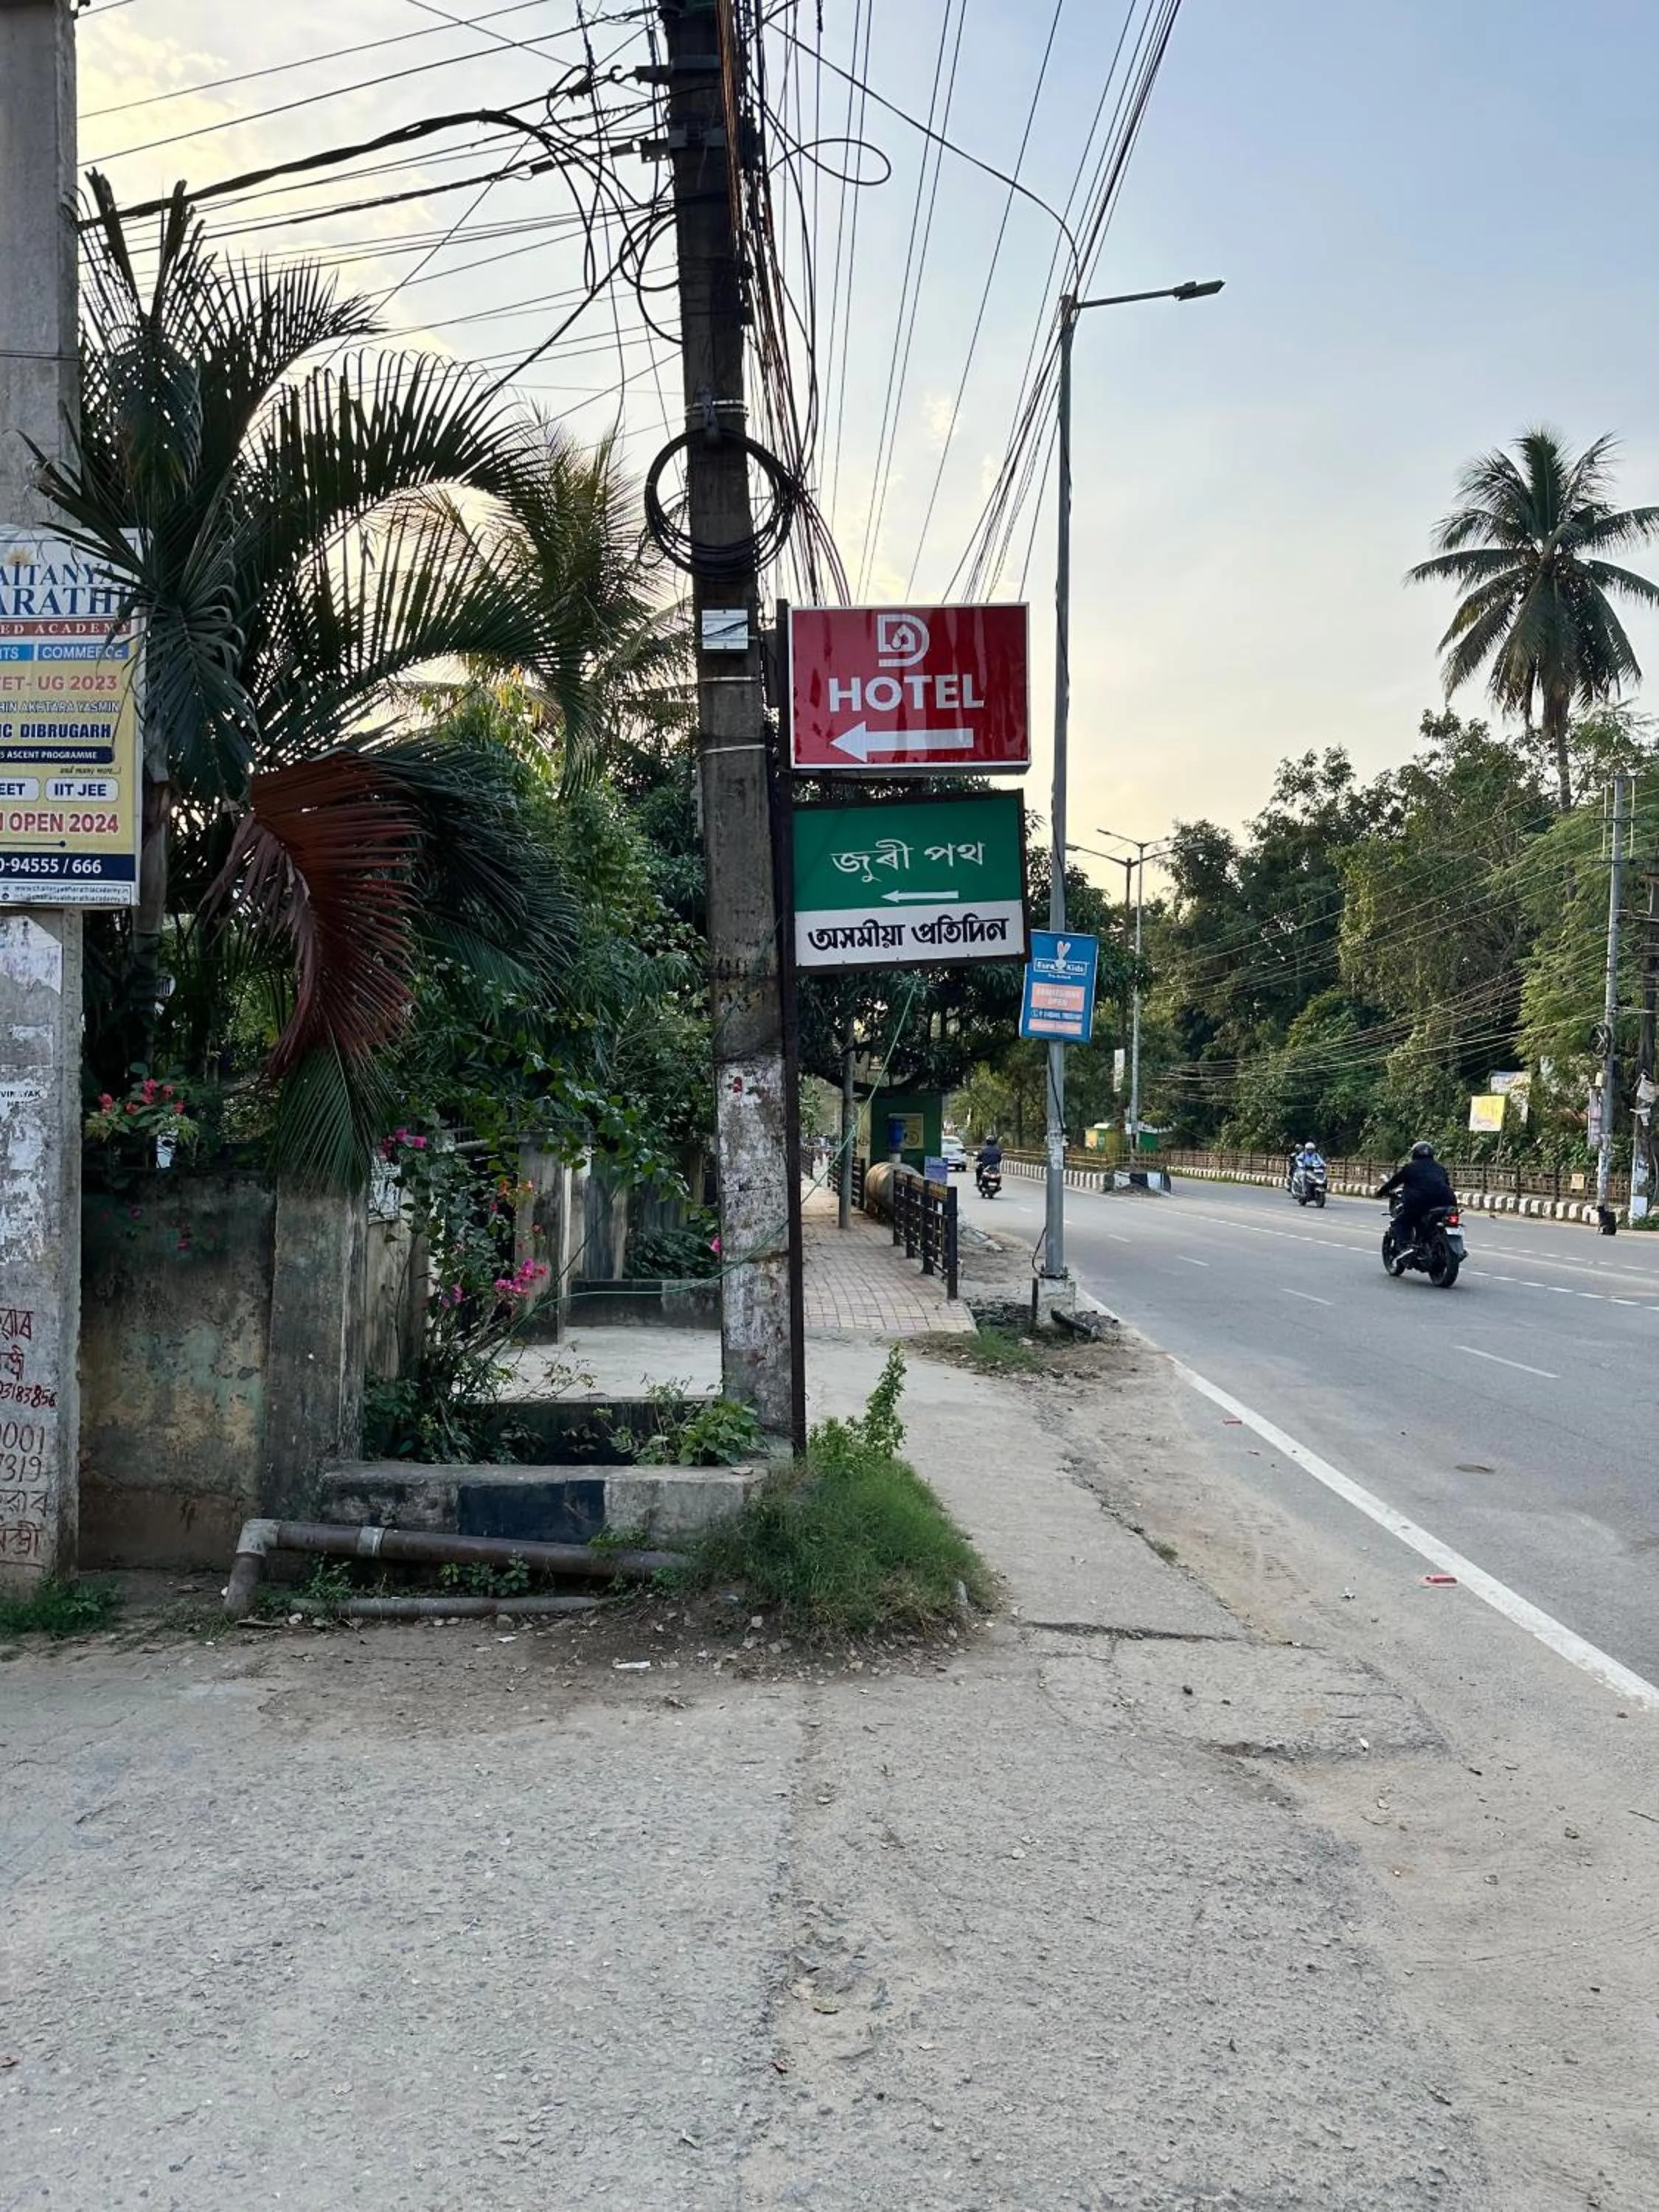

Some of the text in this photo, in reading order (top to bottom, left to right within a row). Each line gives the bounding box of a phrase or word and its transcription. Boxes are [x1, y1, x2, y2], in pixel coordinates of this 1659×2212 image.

[0, 647, 18, 660] TS
[0, 675, 117, 691] ET- UG 2023
[828, 674, 984, 712] HOTEL
[20, 724, 111, 738] DIBRUGARH
[7, 751, 39, 759] ASCENT
[41, 751, 97, 759] PROGRAMME
[55, 784, 74, 796] IIT
[78, 784, 107, 796] JEE
[10, 813, 119, 833] OPEN 2024
[924, 840, 987, 868] পথ
[72, 859, 102, 874] 666
[0, 1422, 45, 1454] 001
